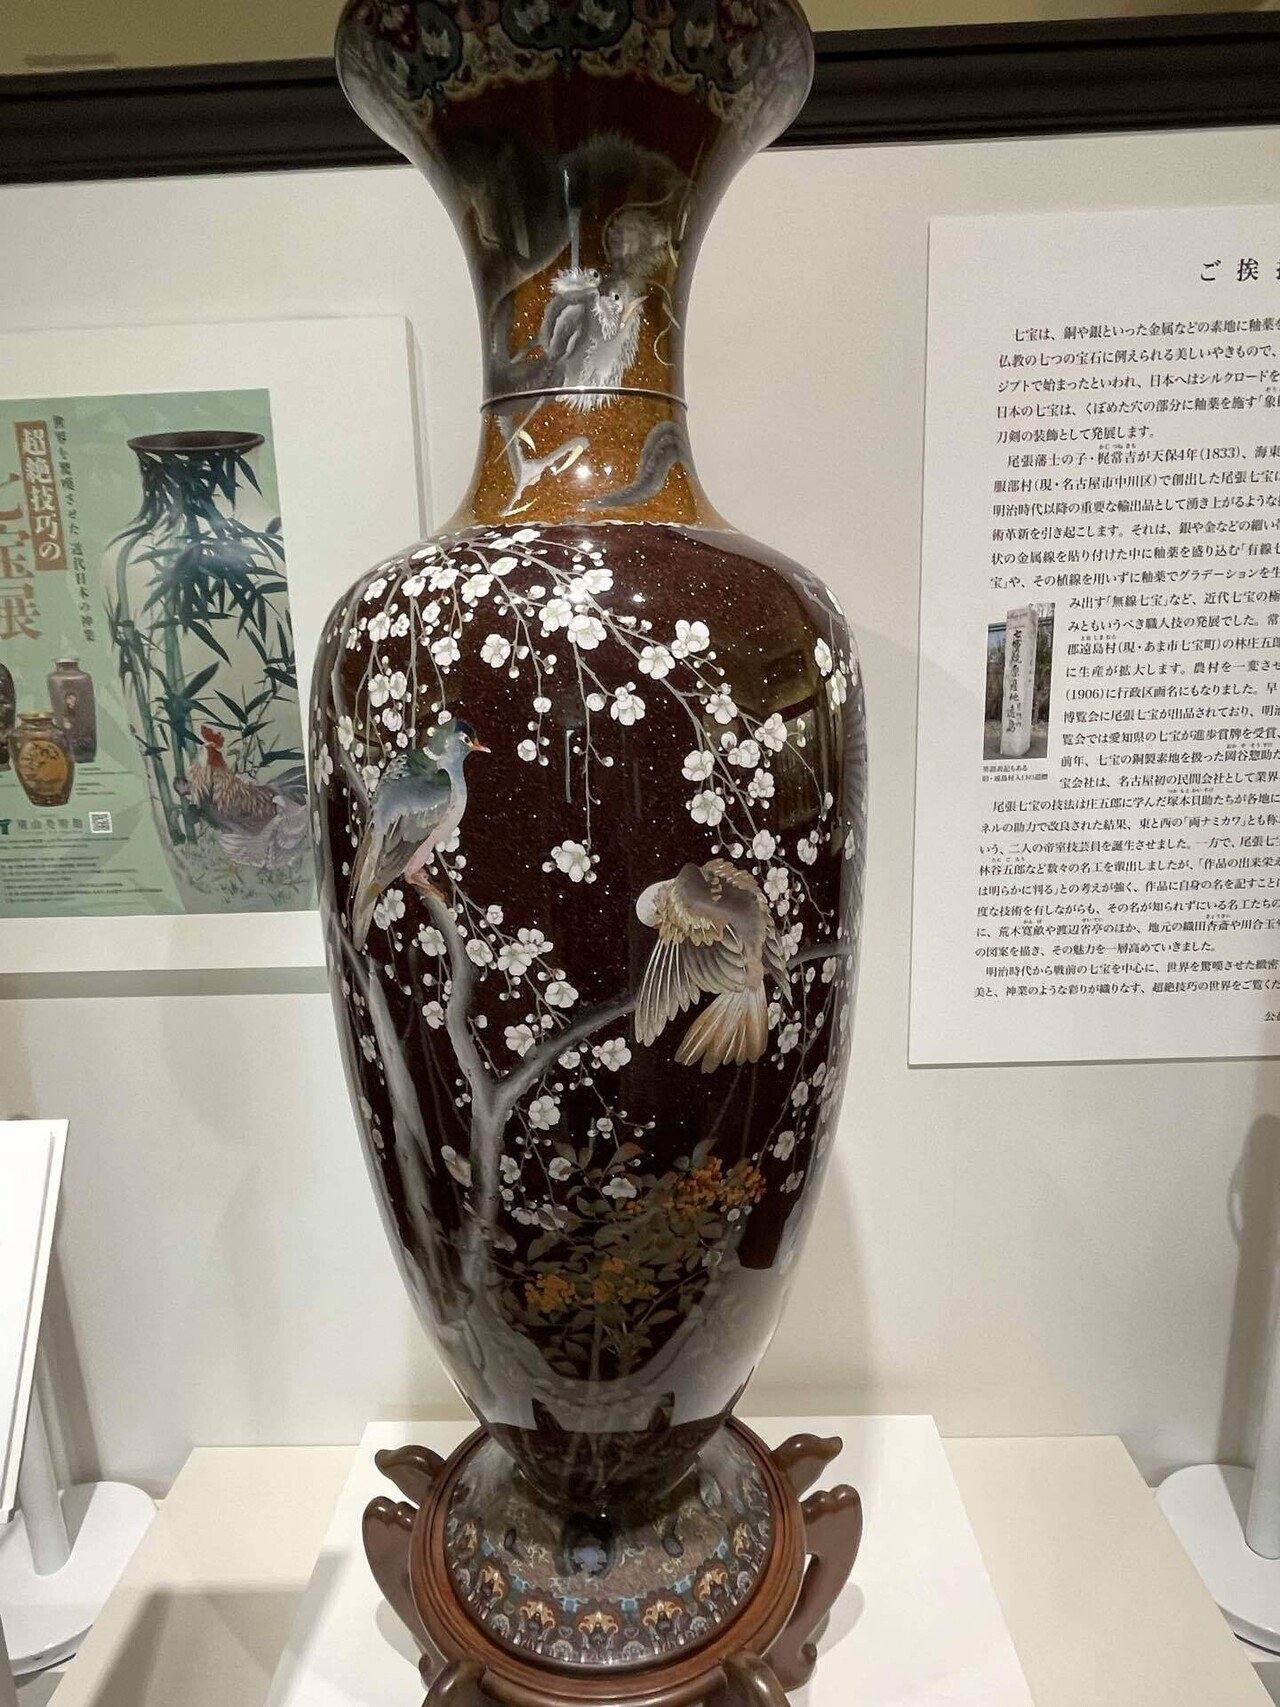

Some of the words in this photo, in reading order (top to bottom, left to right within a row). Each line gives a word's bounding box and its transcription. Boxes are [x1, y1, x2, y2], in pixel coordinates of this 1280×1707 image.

[1200, 258, 1280, 281] ご挨
[997, 395, 1280, 419] 日本の七宝は、くぼめた穴の部分に釉薬を施す「象
[996, 426, 1154, 444] 刀剣の装飾として発展します。
[22, 428, 62, 561] 超絶技巧の
[993, 495, 1280, 517] 明治時代以降の重要な輸出品として湧き上がるような
[978, 877, 1280, 896] は明らかに判る」との考えが強く、作品に自身の名を記すこと
